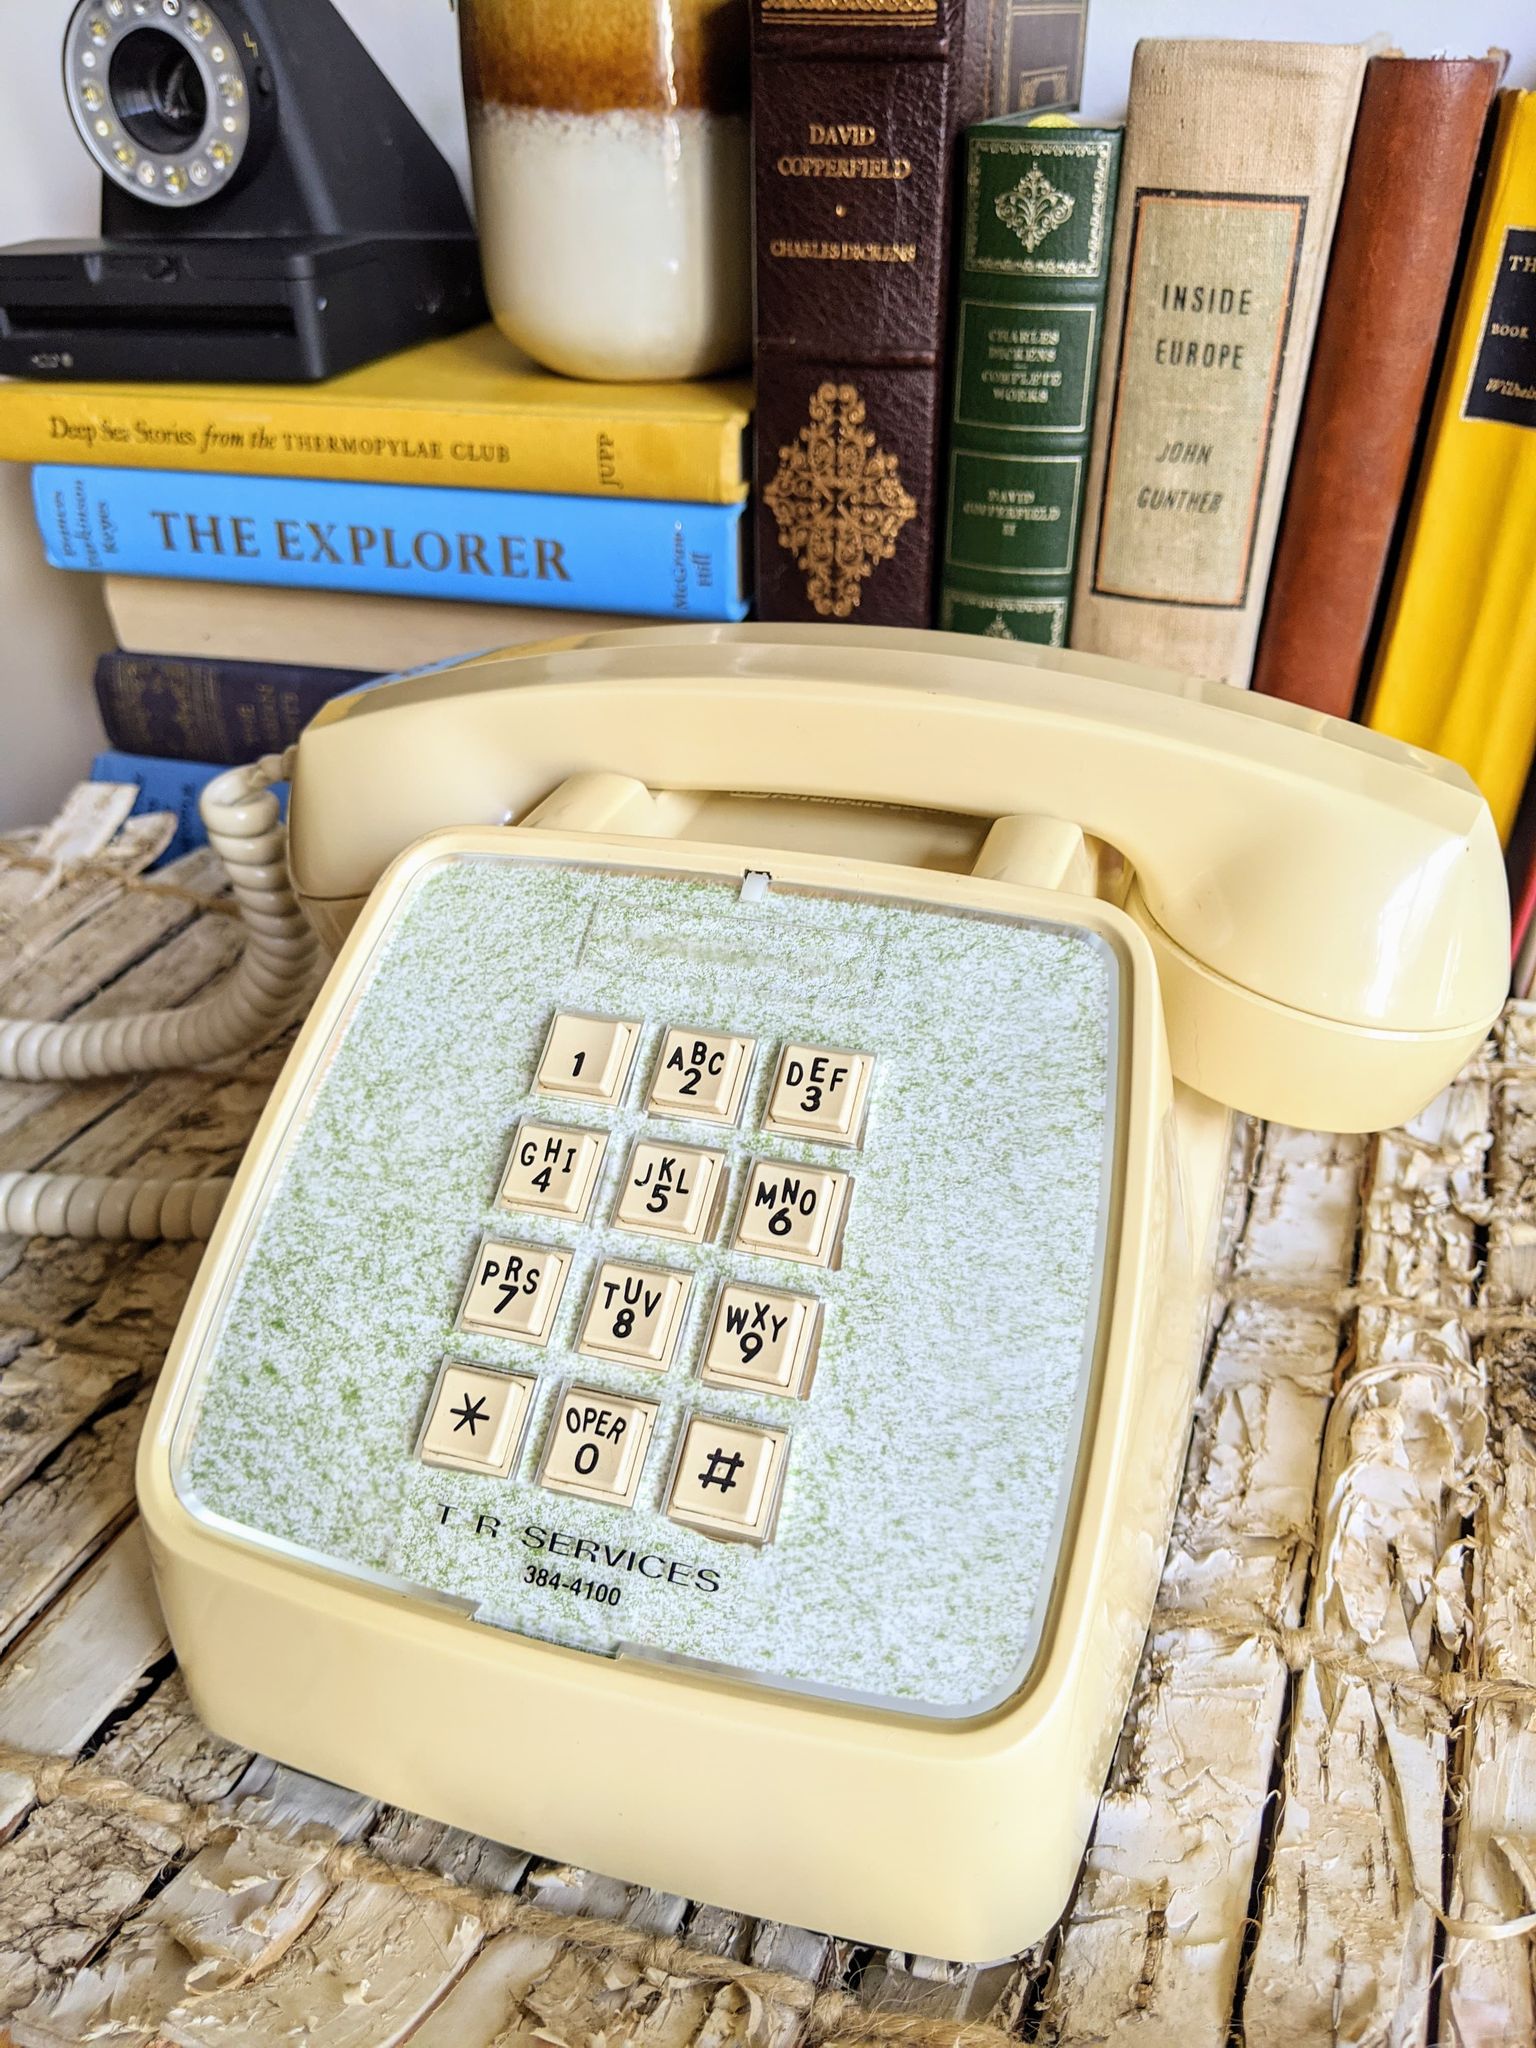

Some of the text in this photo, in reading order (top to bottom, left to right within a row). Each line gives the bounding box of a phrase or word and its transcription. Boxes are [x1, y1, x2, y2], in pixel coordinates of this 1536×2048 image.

[808, 123, 877, 146] DAVID
[777, 156, 913, 180] COPPERFIELD
[1161, 284, 1252, 316] INSIDE
[988, 329, 1061, 346] CHARLES
[1490, 322, 1529, 339] BOOK
[1154, 338, 1245, 370] EUROPE
[50, 417, 97, 448] Deep
[134, 421, 195, 446] Stories
[200, 424, 245, 454] from
[250, 427, 277, 450] the
[282, 432, 442, 460] THERMOPYLAE
[450, 444, 510, 463] CLUB
[1155, 440, 1215, 466] JOHN
[597, 431, 624, 489] JUPP
[1136, 485, 1224, 514] GUNTHER
[150, 510, 573, 583] THE EXPLORER
[573, 1051, 586, 1077] 1
[667, 1041, 725, 1076] ABC
[785, 1057, 848, 1092] DEF
[679, 1066, 702, 1096] 2
[800, 1085, 822, 1112] 3
[520, 1137, 577, 1173] GHI
[531, 1166, 552, 1193] 4
[634, 1157, 690, 1195] JKL
[646, 1184, 671, 1213] 5
[754, 1177, 817, 1216] MNO
[768, 1205, 792, 1236] 6
[480, 1255, 541, 1295] PRS
[495, 1284, 519, 1314] 7
[603, 1277, 662, 1318] TUV
[612, 1308, 635, 1339] 8
[726, 1301, 788, 1343] WXY
[739, 1331, 763, 1364] 9
[566, 1407, 627, 1445] OPER
[698, 1447, 745, 1494] #
[438, 1503, 721, 1593] T R SERVICES
[523, 1564, 622, 1607] 384-4100
